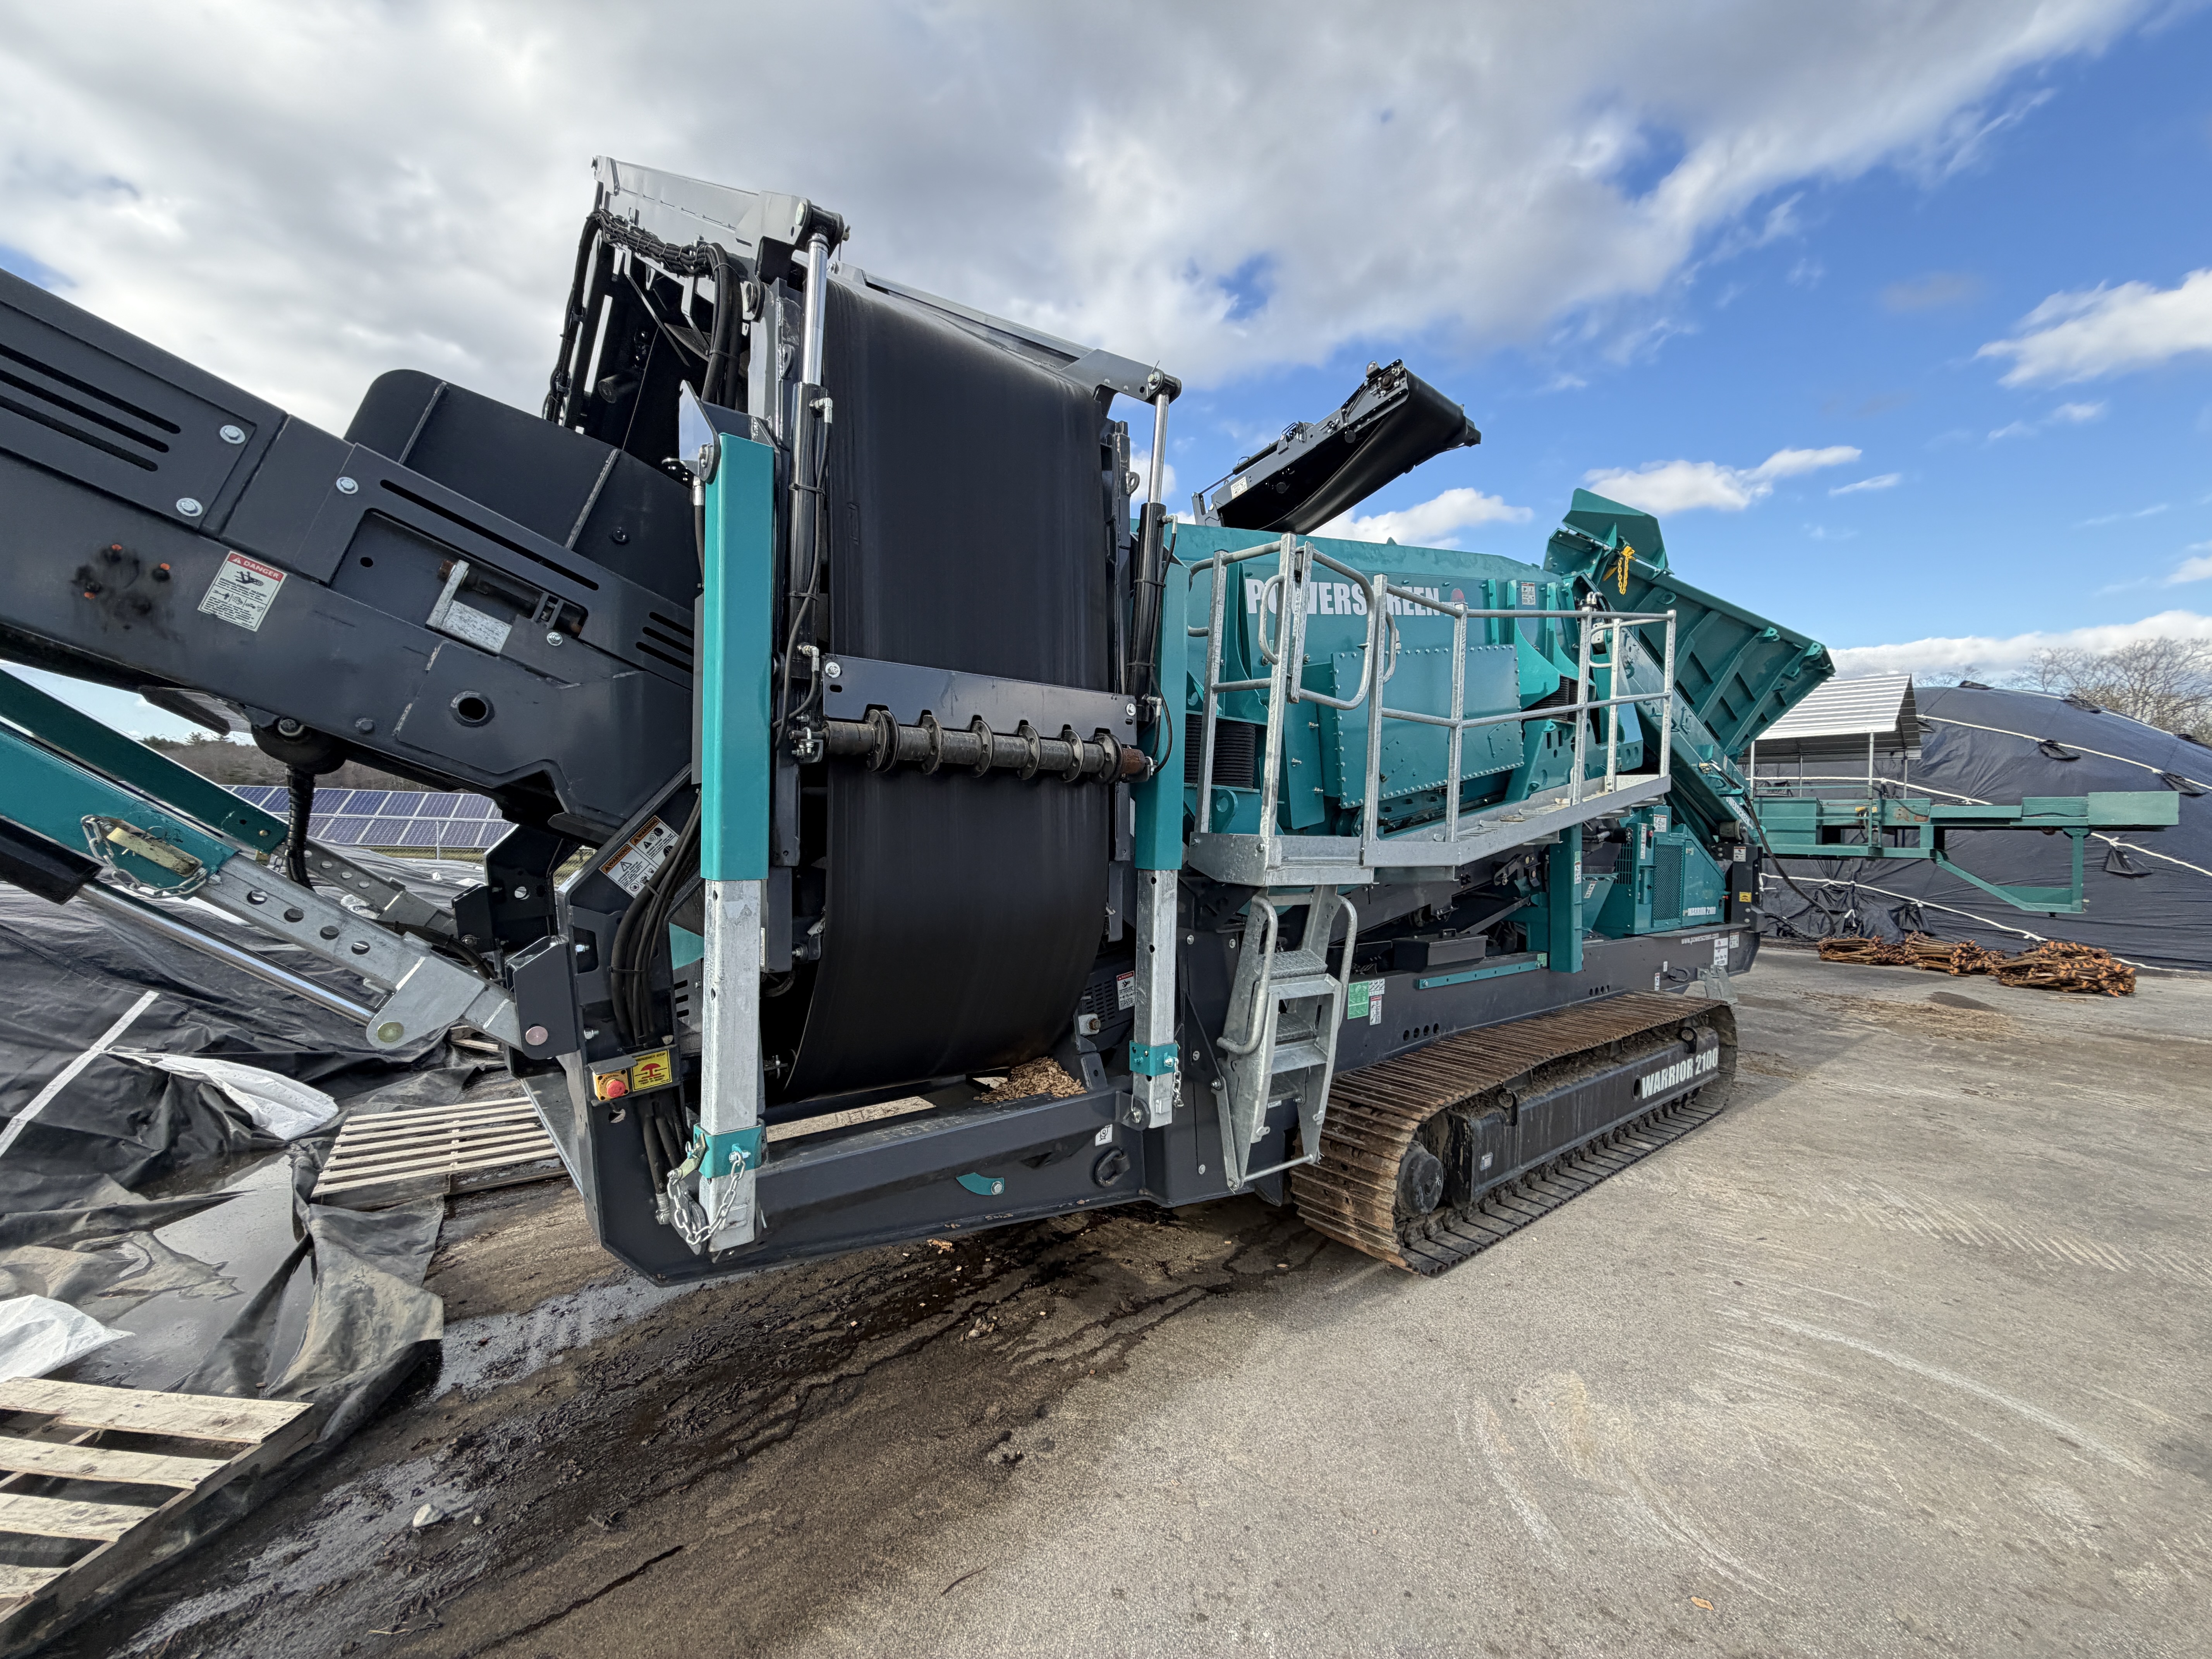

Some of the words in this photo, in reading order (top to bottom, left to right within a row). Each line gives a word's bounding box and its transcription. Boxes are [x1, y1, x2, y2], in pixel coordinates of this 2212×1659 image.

[243, 560, 279, 579] DANGER
[1245, 579, 1440, 616] PERSREEN
[607, 845, 630, 866] WARNING
[1642, 1058, 1694, 1099] WARRIOR
[1695, 1048, 1719, 1075] 2100
